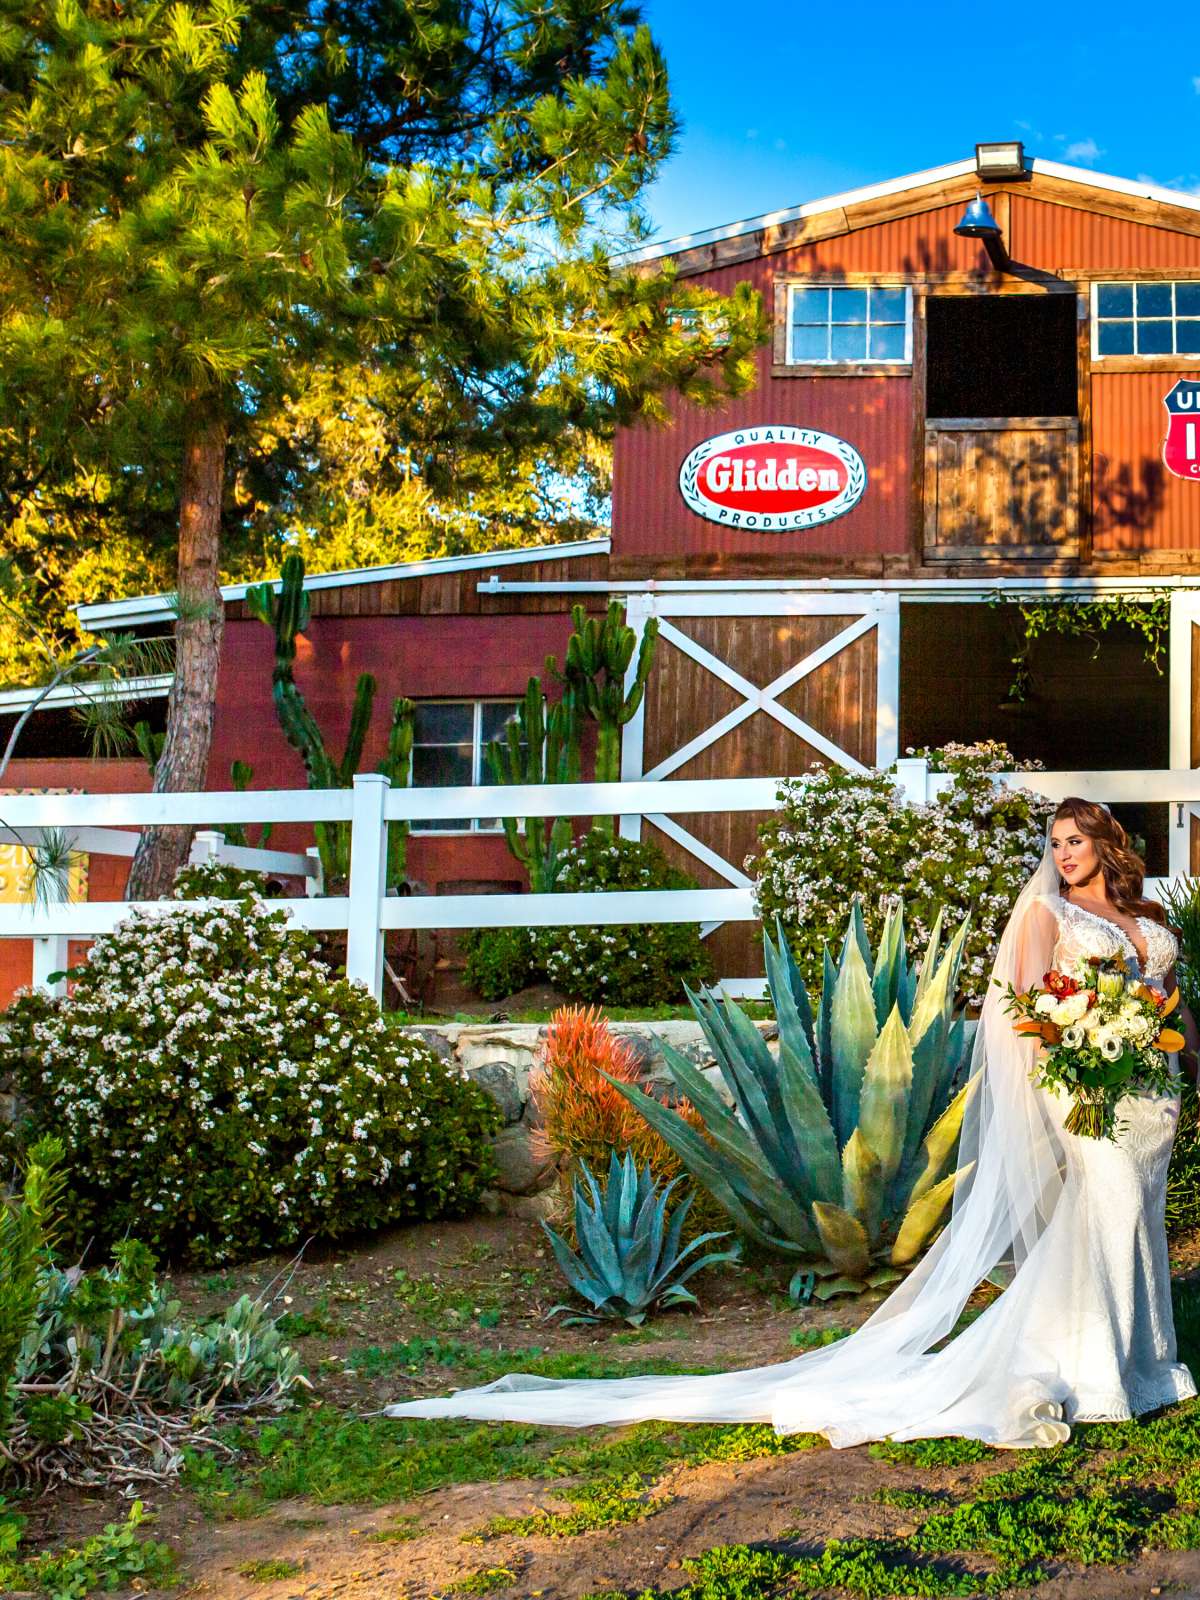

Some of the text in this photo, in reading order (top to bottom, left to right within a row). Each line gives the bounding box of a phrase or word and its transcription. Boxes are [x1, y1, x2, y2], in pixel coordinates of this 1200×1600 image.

[734, 430, 822, 445] QUALITY
[705, 456, 841, 493] Glidden
[718, 508, 827, 527] PRODUCTS
